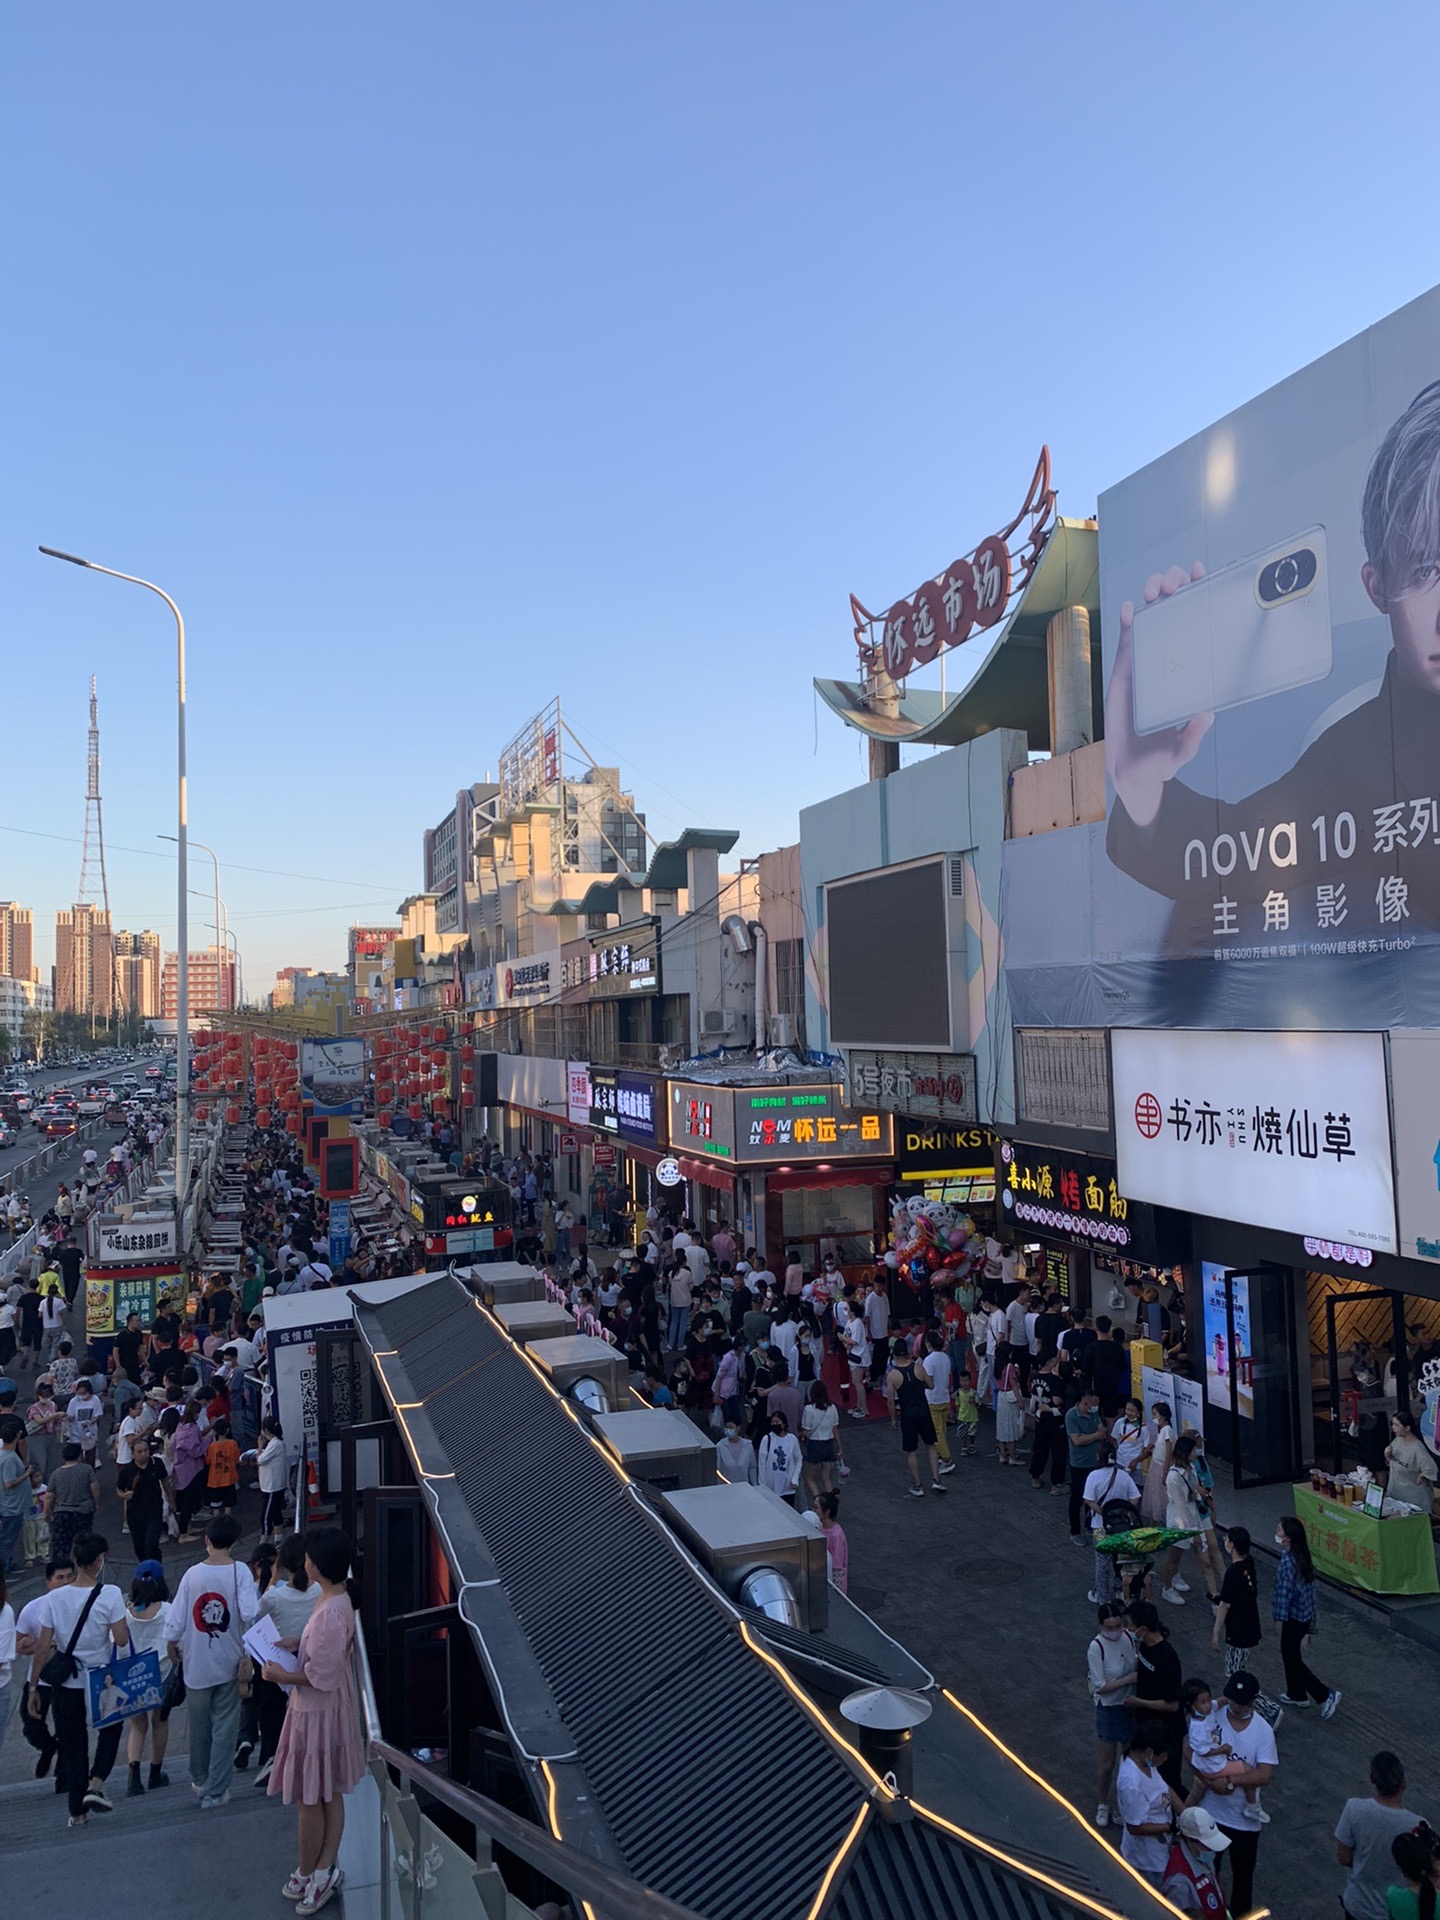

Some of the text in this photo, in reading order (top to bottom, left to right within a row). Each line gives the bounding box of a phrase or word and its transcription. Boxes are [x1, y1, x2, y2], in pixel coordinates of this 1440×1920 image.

[885, 550, 1000, 669] 怀远市场
[1184, 797, 1440, 881] nova 10 系列
[1213, 875, 1410, 935] 主角影像
[853, 1063, 913, 1098] 5号夜市
[793, 1115, 881, 1143] 怀远一品
[906, 1129, 1000, 1151] DRINKST
[1167, 1097, 1222, 1145] 书亦
